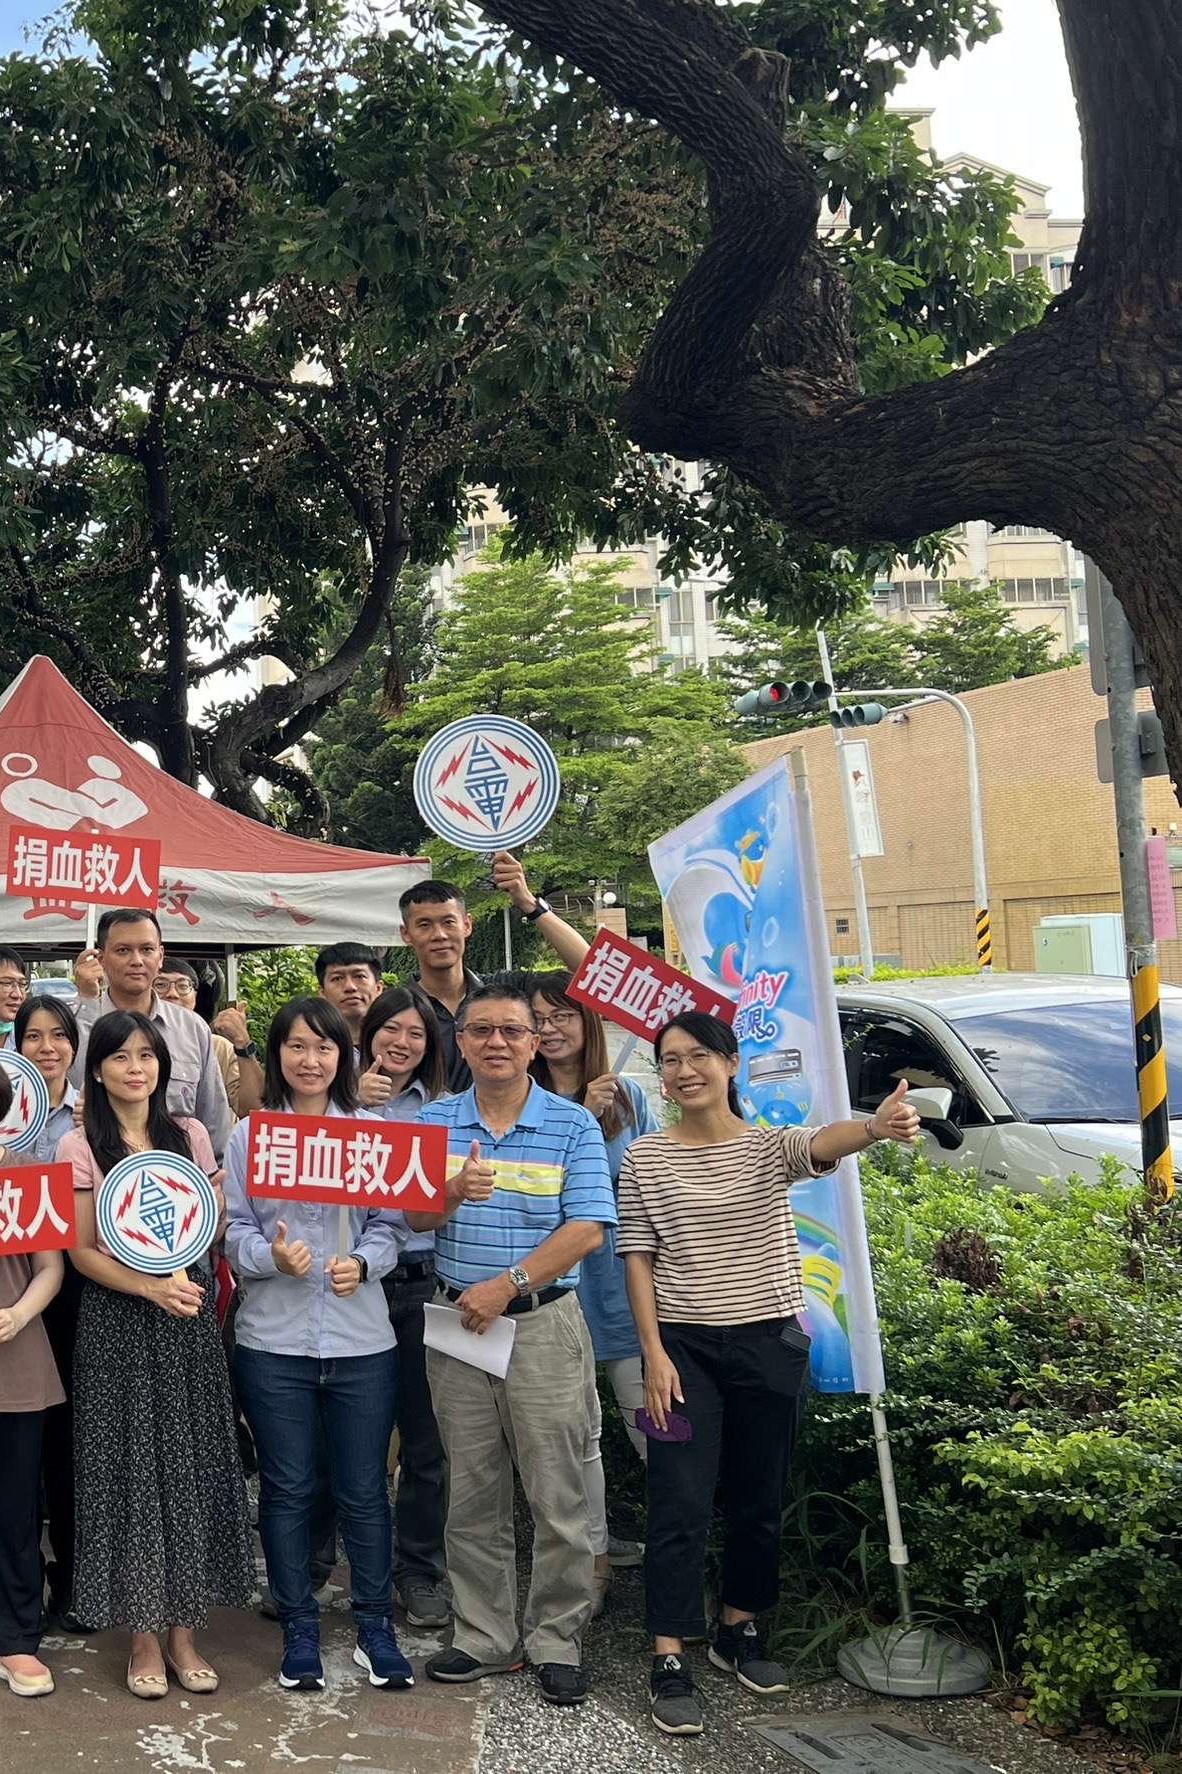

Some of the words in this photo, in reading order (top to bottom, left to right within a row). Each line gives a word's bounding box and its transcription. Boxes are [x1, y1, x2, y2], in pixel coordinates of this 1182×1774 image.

[12, 835, 153, 897] 捐血救人
[577, 941, 721, 1030] 捐血救
[253, 1122, 438, 1199] 捐血救人
